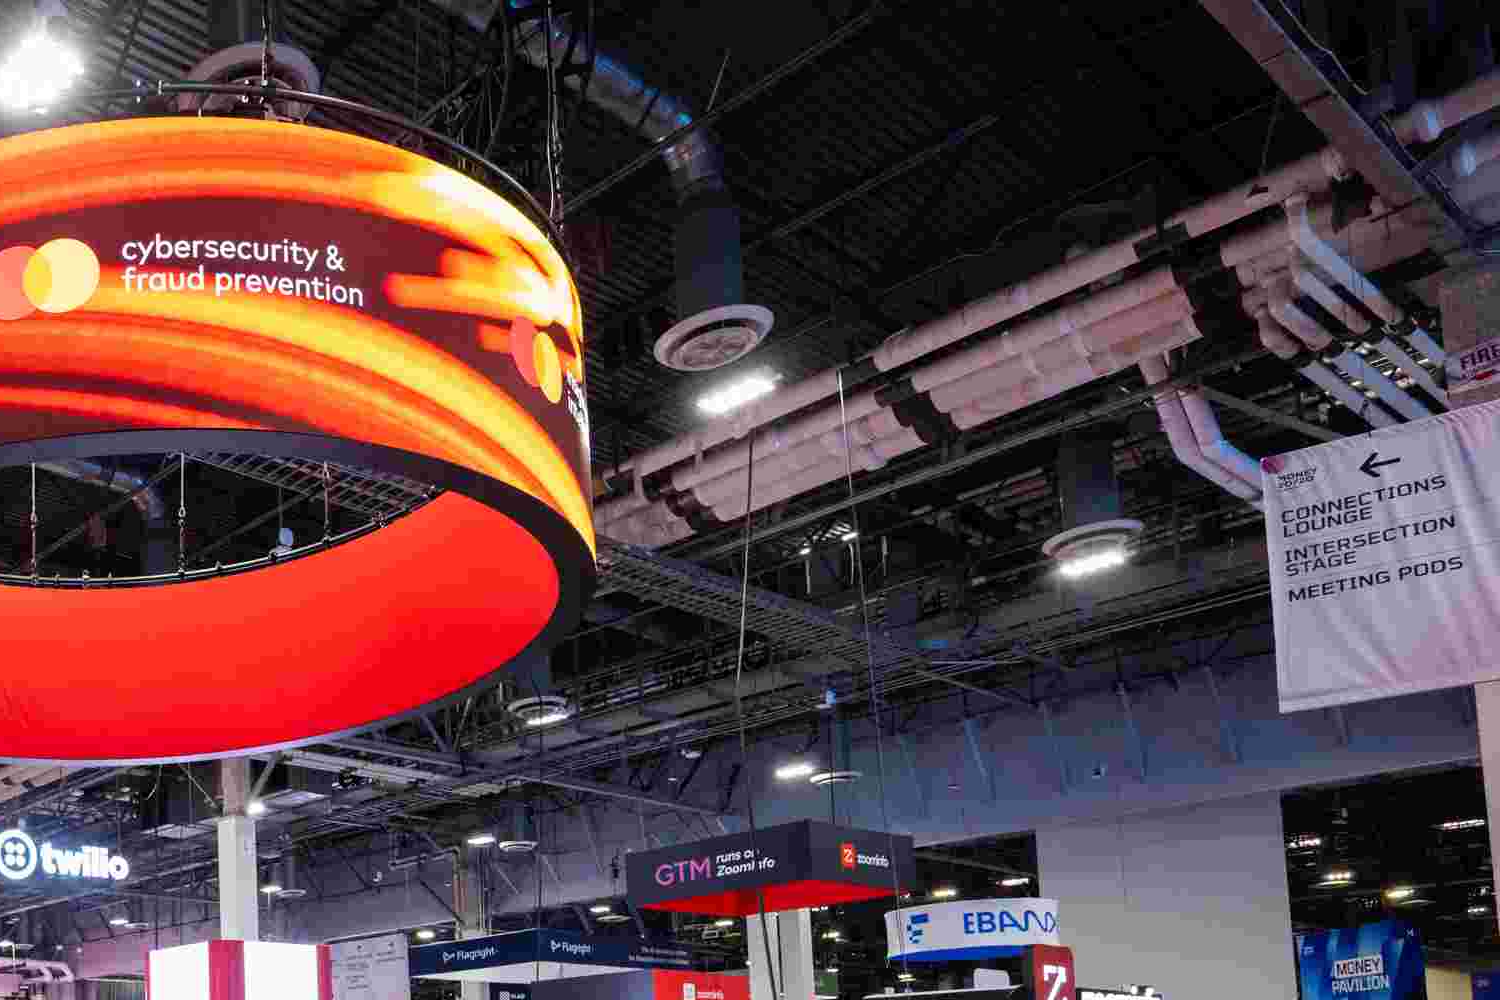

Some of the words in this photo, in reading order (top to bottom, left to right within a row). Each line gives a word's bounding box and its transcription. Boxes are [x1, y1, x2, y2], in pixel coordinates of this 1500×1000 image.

[121, 233, 318, 272] cybersecurity
[325, 245, 346, 271] &
[121, 264, 205, 293] fraud
[215, 271, 364, 307] prevention
[1281, 475, 1447, 524] CONNECTIONS
[1283, 506, 1373, 538] LOUNGE
[1285, 514, 1457, 563] INTERSECTION
[1286, 551, 1357, 577] STAGE
[1288, 570, 1391, 602] MEETING
[1399, 557, 1464, 581] PODS
[41, 842, 130, 880] twilio
[654, 857, 712, 887] GTM
[715, 850, 742, 864] runs
[1332, 975, 1390, 992] PAVILION
[1336, 957, 1381, 976] MONEY
